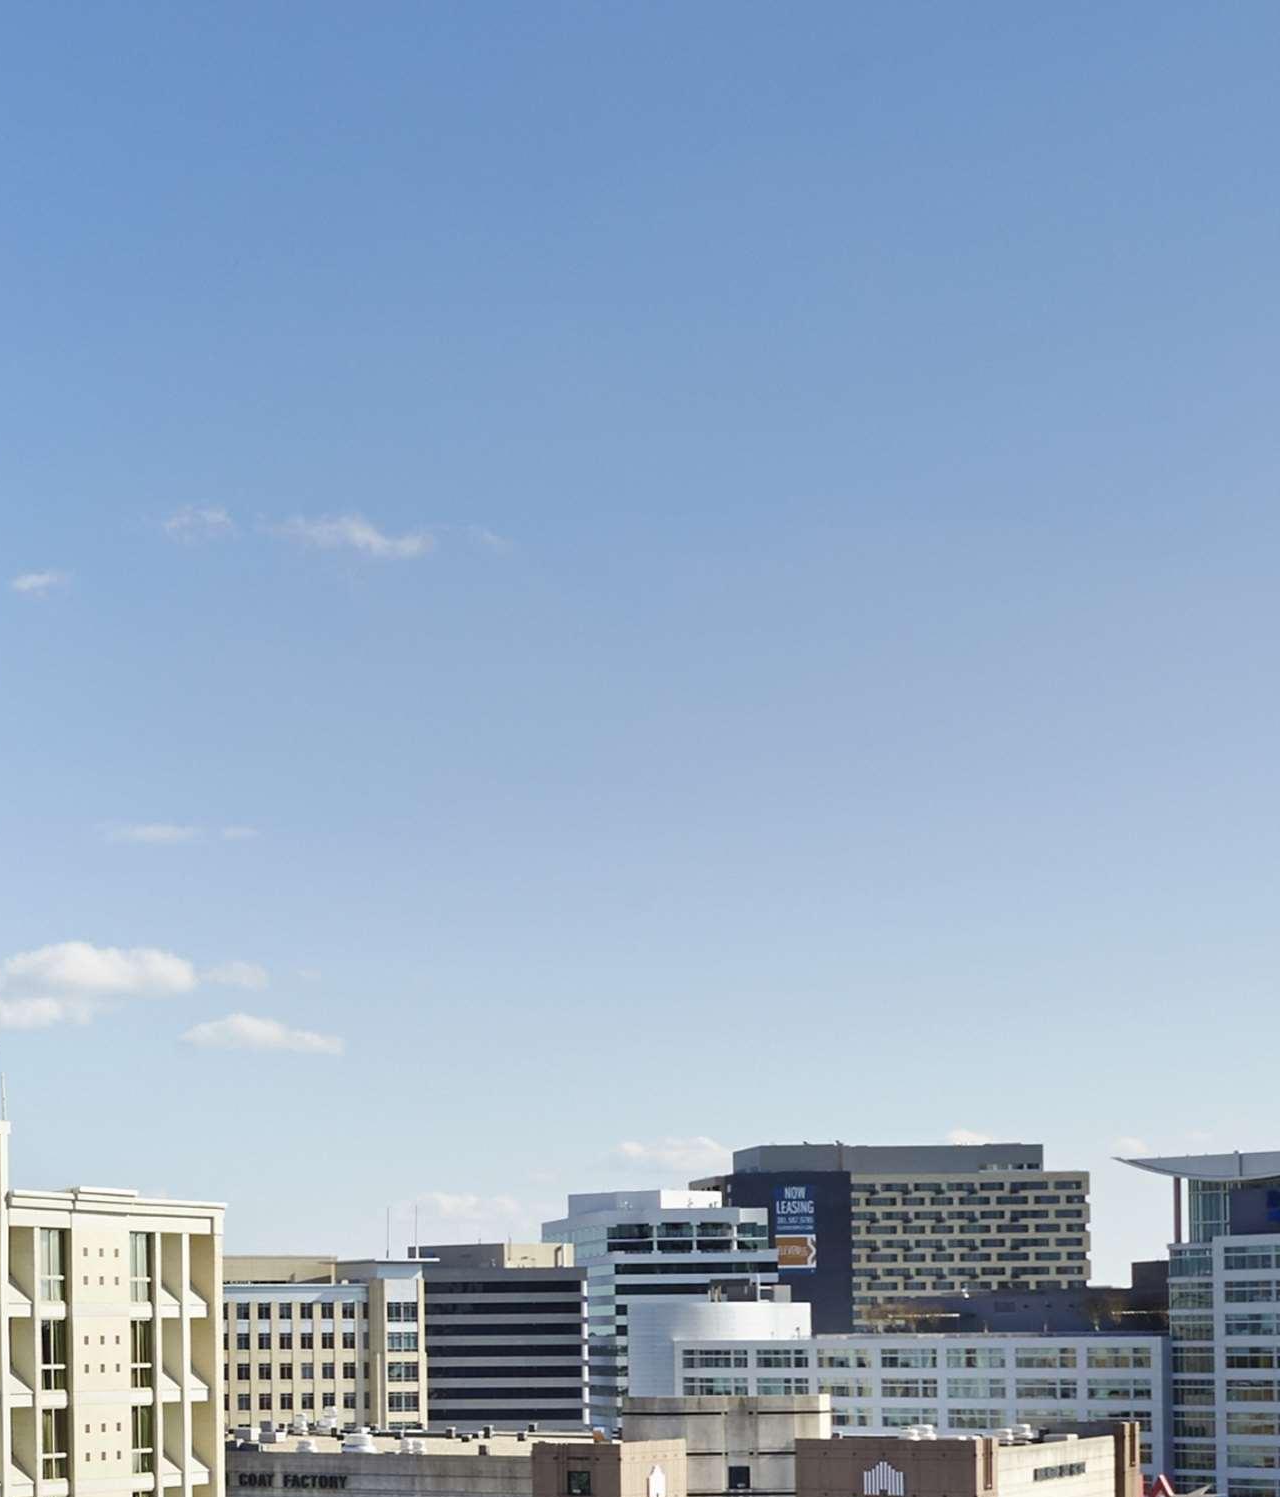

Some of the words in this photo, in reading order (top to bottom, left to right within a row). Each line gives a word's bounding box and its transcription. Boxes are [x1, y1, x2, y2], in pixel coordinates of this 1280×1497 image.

[784, 1186, 806, 1199] NOW
[776, 1200, 815, 1214] LEASING
[238, 1472, 274, 1487] COAT
[283, 1473, 348, 1489] FACTORY
